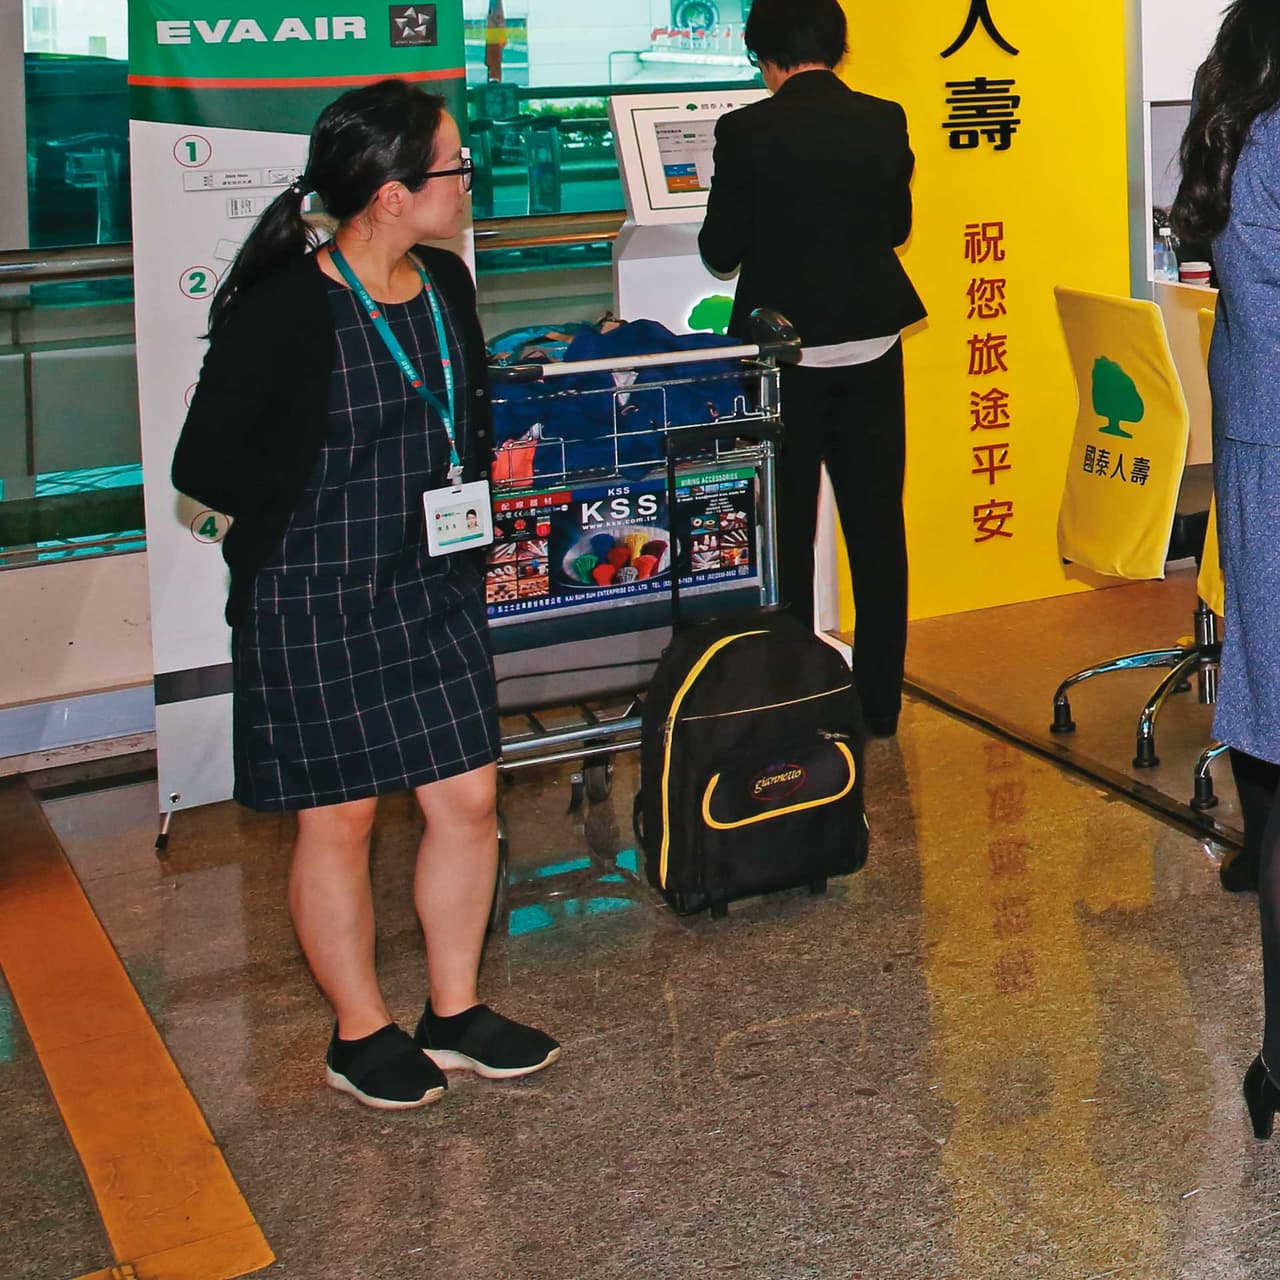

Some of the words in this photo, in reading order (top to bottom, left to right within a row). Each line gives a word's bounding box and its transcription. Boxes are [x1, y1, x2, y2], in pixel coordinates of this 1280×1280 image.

[185, 141, 197, 162] 1
[189, 271, 207, 293] 2
[963, 220, 1013, 544] 祝您旅途平安
[1083, 444, 1151, 486] 國泰人壽
[607, 486, 630, 497] KSS
[581, 494, 658, 524] KSS
[199, 515, 218, 538] 4
